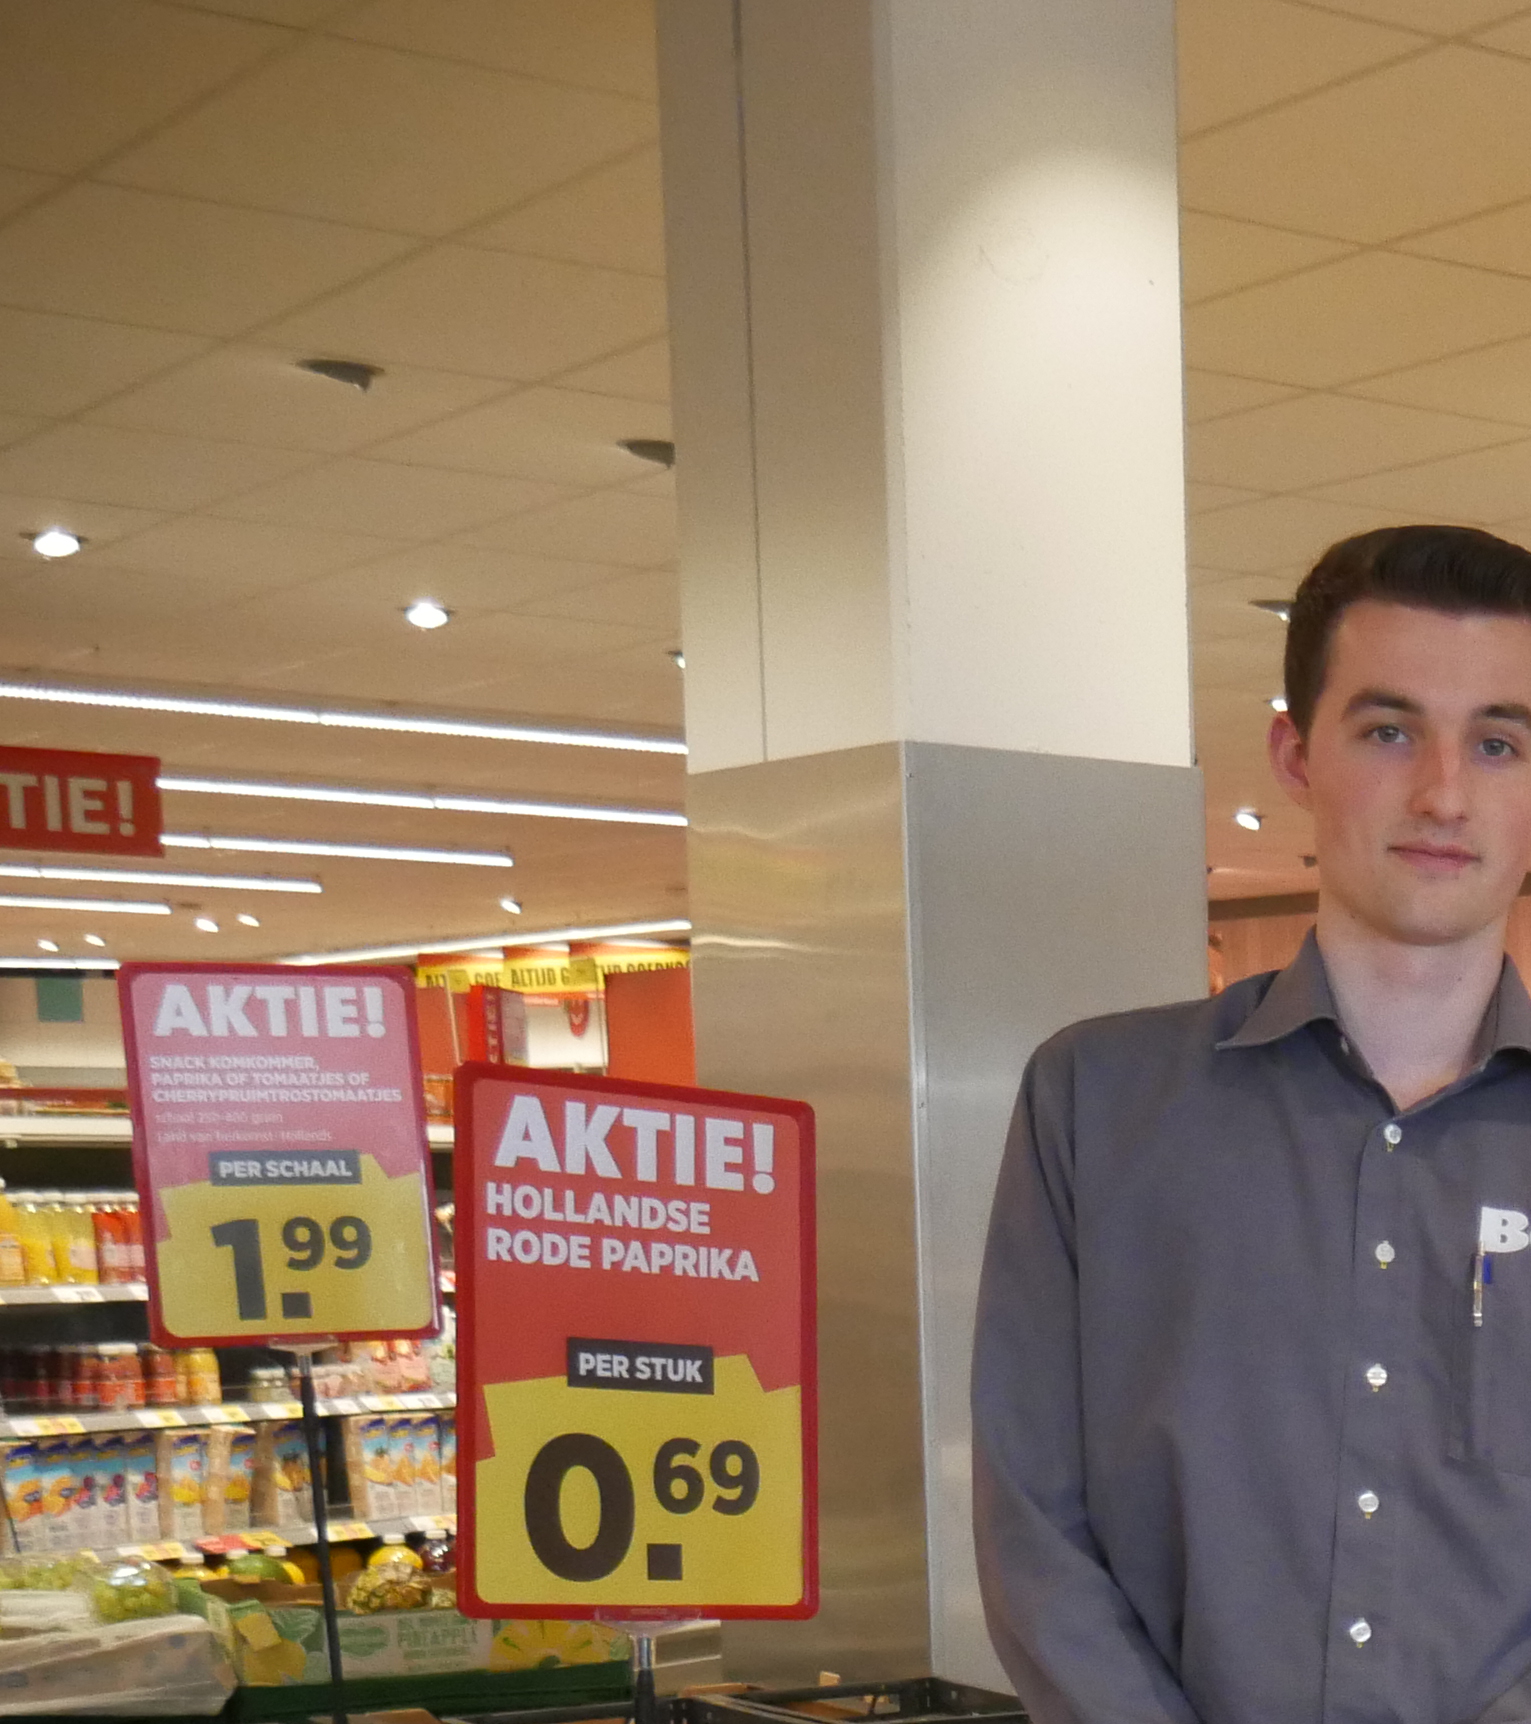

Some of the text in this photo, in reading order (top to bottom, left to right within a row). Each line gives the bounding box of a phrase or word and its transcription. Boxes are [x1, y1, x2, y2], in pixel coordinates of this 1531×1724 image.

[152, 983, 387, 1038] AKTIE!
[152, 1072, 222, 1086] PAPRIKA
[227, 1073, 248, 1086] OF
[349, 1072, 369, 1085] OF
[219, 1160, 353, 1178] PER SCHAAL
[494, 1095, 775, 1195] AKTIE!
[486, 1181, 711, 1234] HOLLANDSE
[486, 1228, 760, 1282] RODE PAPRIKA
[579, 1350, 703, 1383] PER STUK
